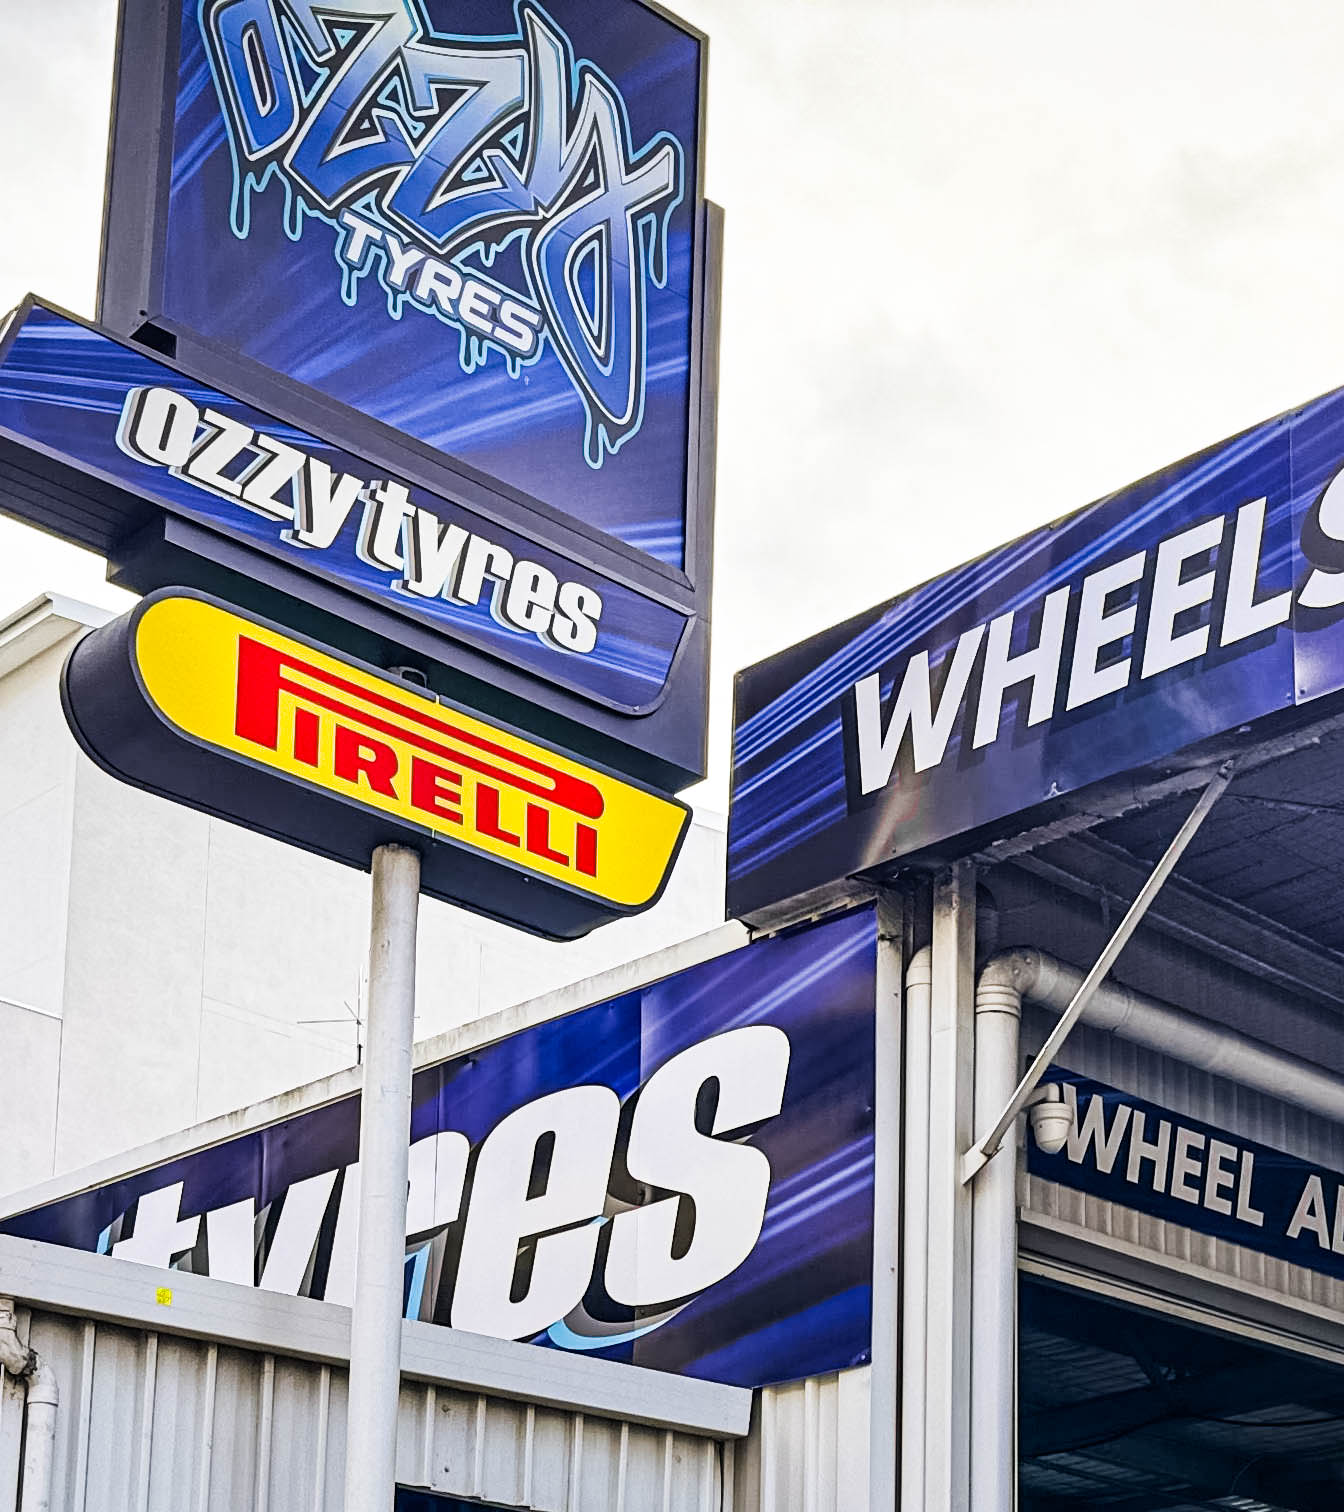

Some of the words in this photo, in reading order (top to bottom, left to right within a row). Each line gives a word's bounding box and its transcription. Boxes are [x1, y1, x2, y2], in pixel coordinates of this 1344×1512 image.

[342, 210, 543, 355] TYRES
[235, 634, 605, 878] PIRELLI
[1062, 1082, 1265, 1227] WHEEL
